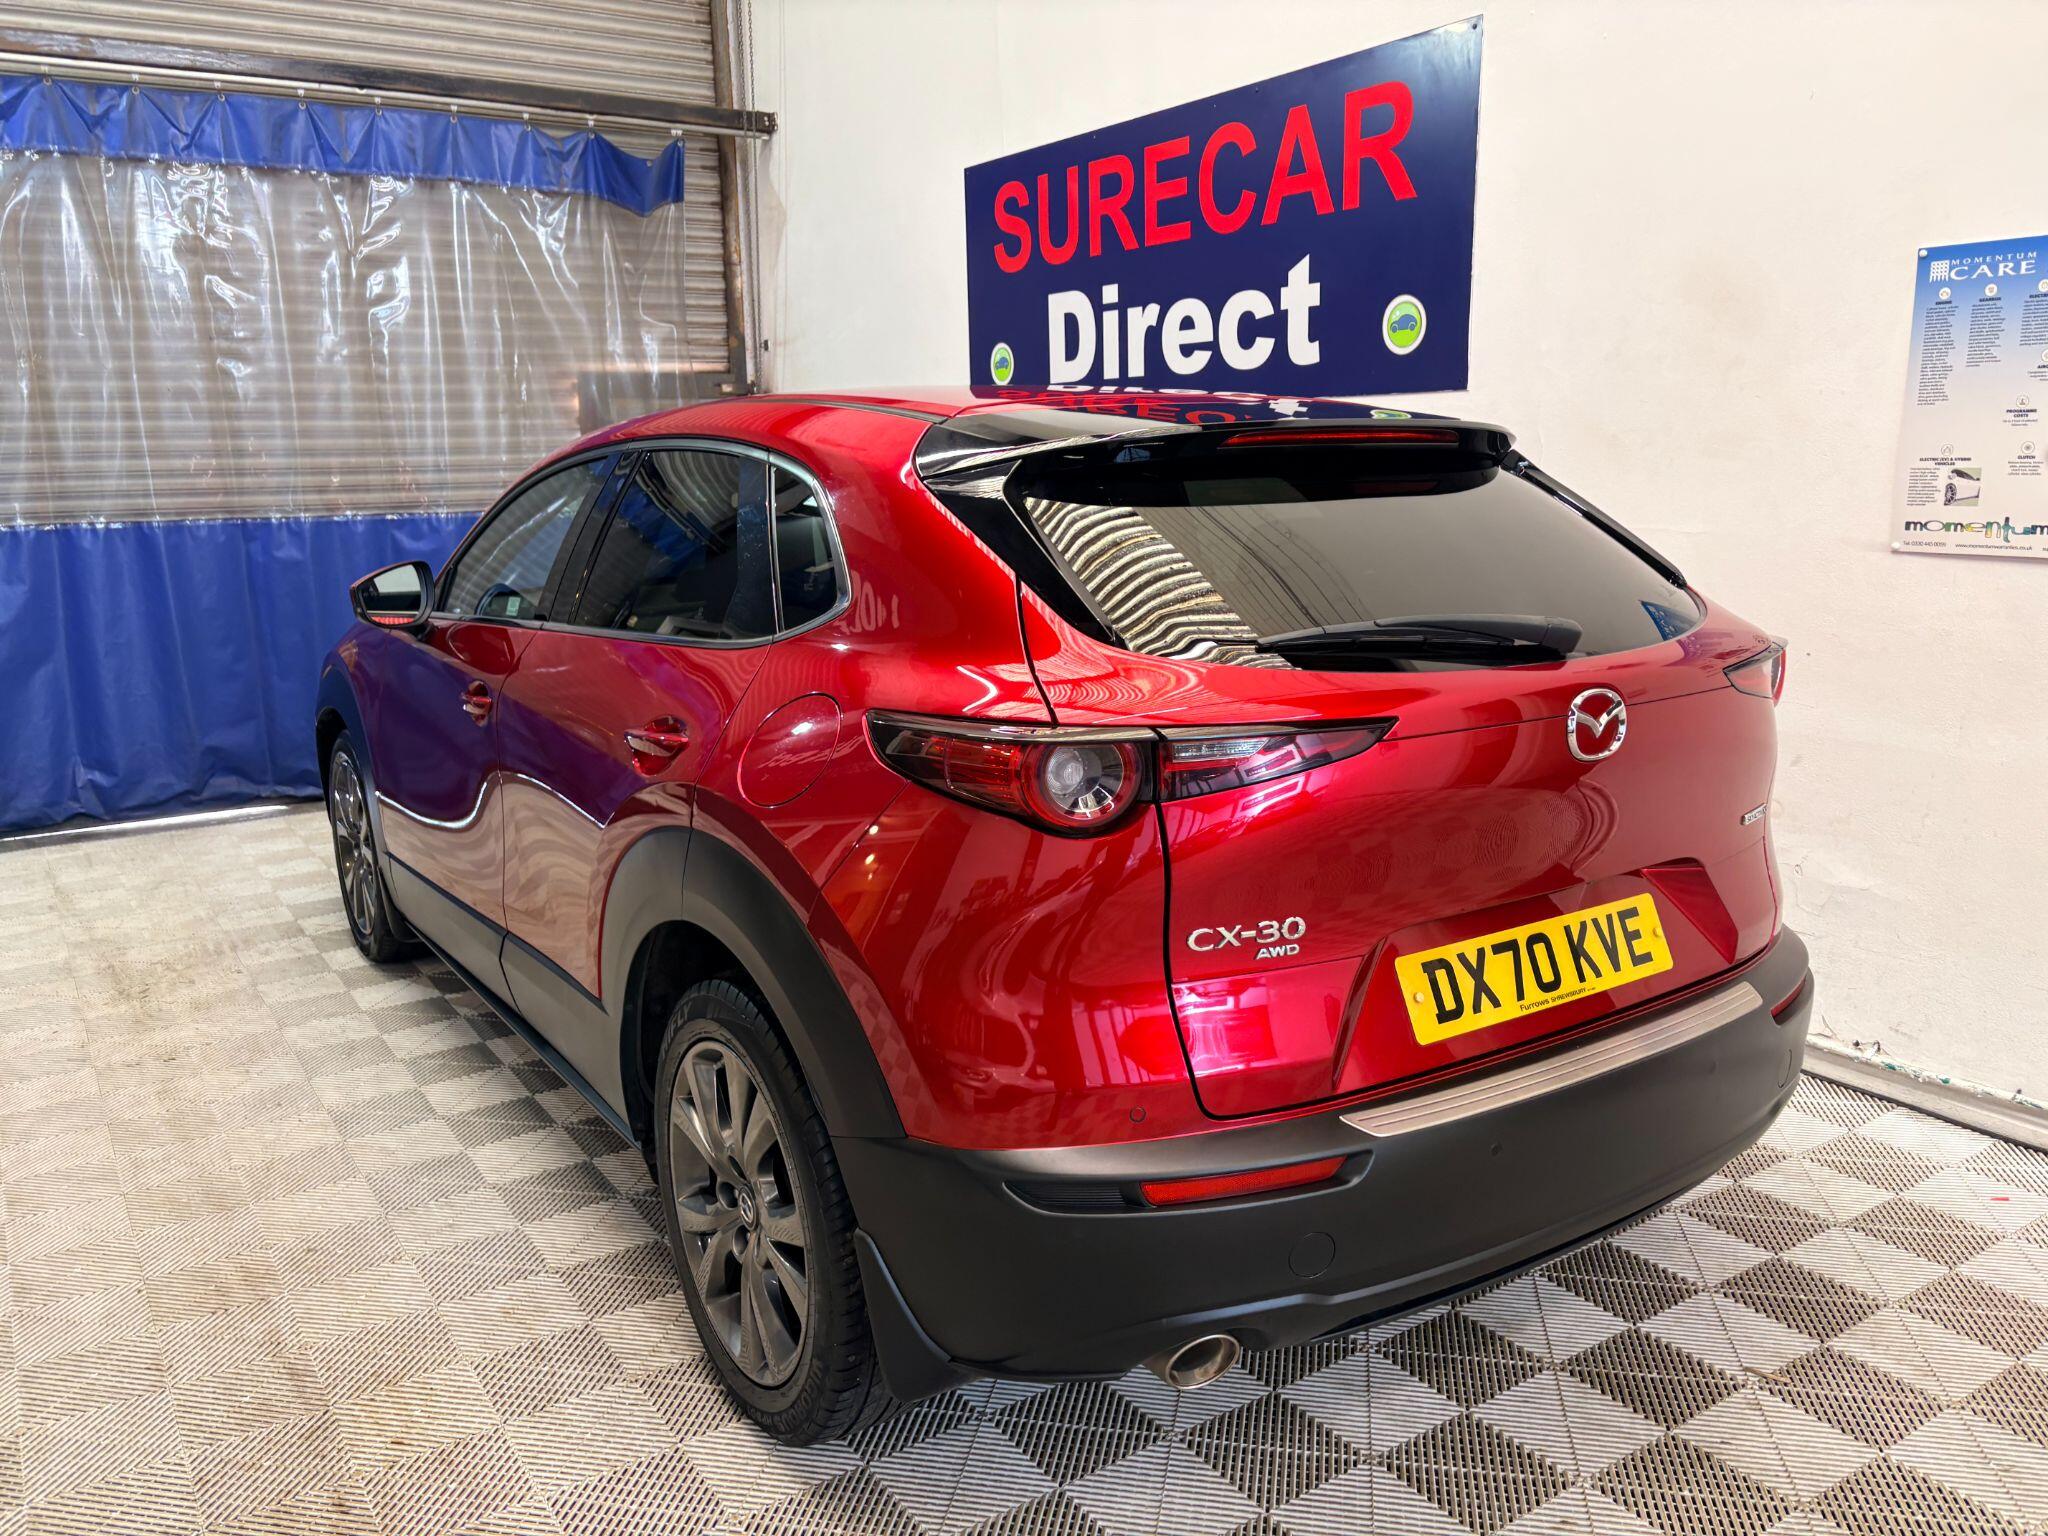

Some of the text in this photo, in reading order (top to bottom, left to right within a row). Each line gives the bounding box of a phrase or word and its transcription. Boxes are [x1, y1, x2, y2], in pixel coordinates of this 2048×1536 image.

[994, 80, 1418, 273] SURECAR
[1950, 260, 2036, 280] CARE
[1951, 251, 2037, 266] MOMENTUM
[1048, 254, 1321, 384] Direct
[1904, 516, 2048, 543] momentum
[1187, 916, 1306, 952] CX-30
[1256, 943, 1300, 960] AWD
[1421, 906, 1654, 1025] DX70 KVE
[1519, 986, 1587, 1012] Furrows SHREWSBURY
